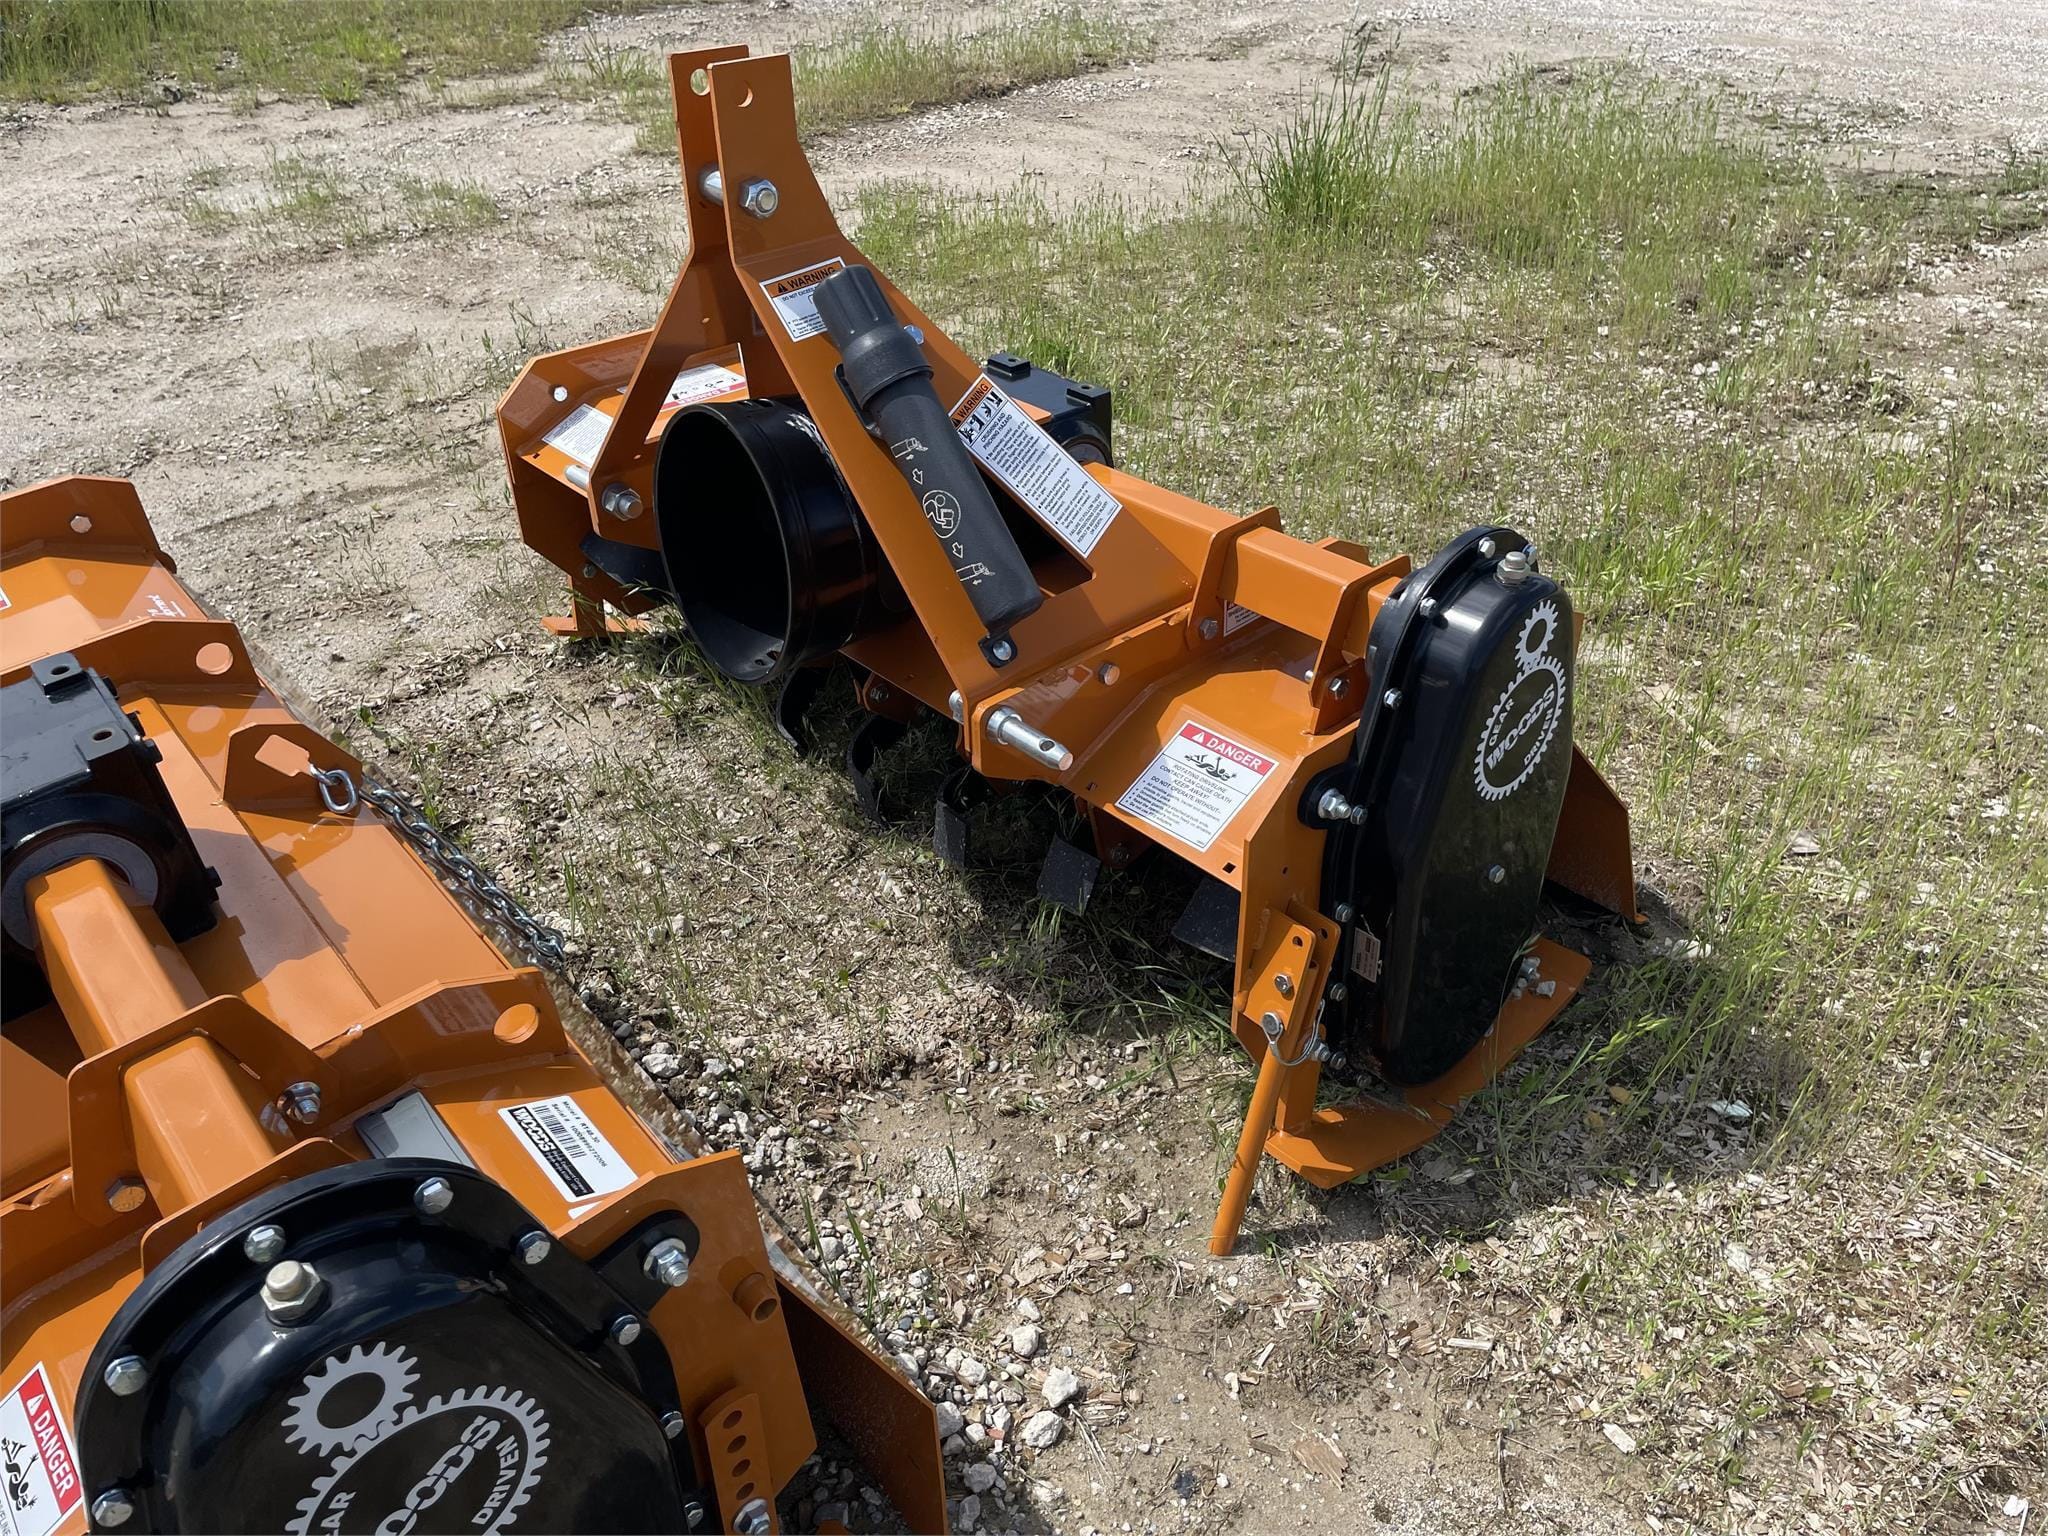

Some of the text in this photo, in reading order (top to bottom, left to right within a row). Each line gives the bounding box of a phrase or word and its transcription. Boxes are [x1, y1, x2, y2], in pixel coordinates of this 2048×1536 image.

[788, 266, 836, 288] WARNING
[956, 382, 989, 420] WARNING
[980, 412, 1006, 442] CRUSHING AND
[982, 413, 1012, 450] PINCHING HAZARD
[1486, 684, 1554, 770] WOODS
[1489, 699, 1514, 746] GEAR
[1524, 708, 1554, 766] DRIVEN
[1172, 763, 1200, 780] ROTATING
[1205, 737, 1264, 770] DANGER
[1158, 764, 1232, 804] CONTACT CAN CAUSE DEATH
[1158, 779, 1171, 788] NOT
[1169, 785, 1195, 800] OPERATE
[1172, 778, 1190, 790] KEEP
[552, 1104, 566, 1118] Serial
[563, 1101, 576, 1116] Model
[512, 1108, 557, 1152] WOODS
[34, 1410, 75, 1498] DANGER
[472, 1435, 520, 1524] DRIVEN
